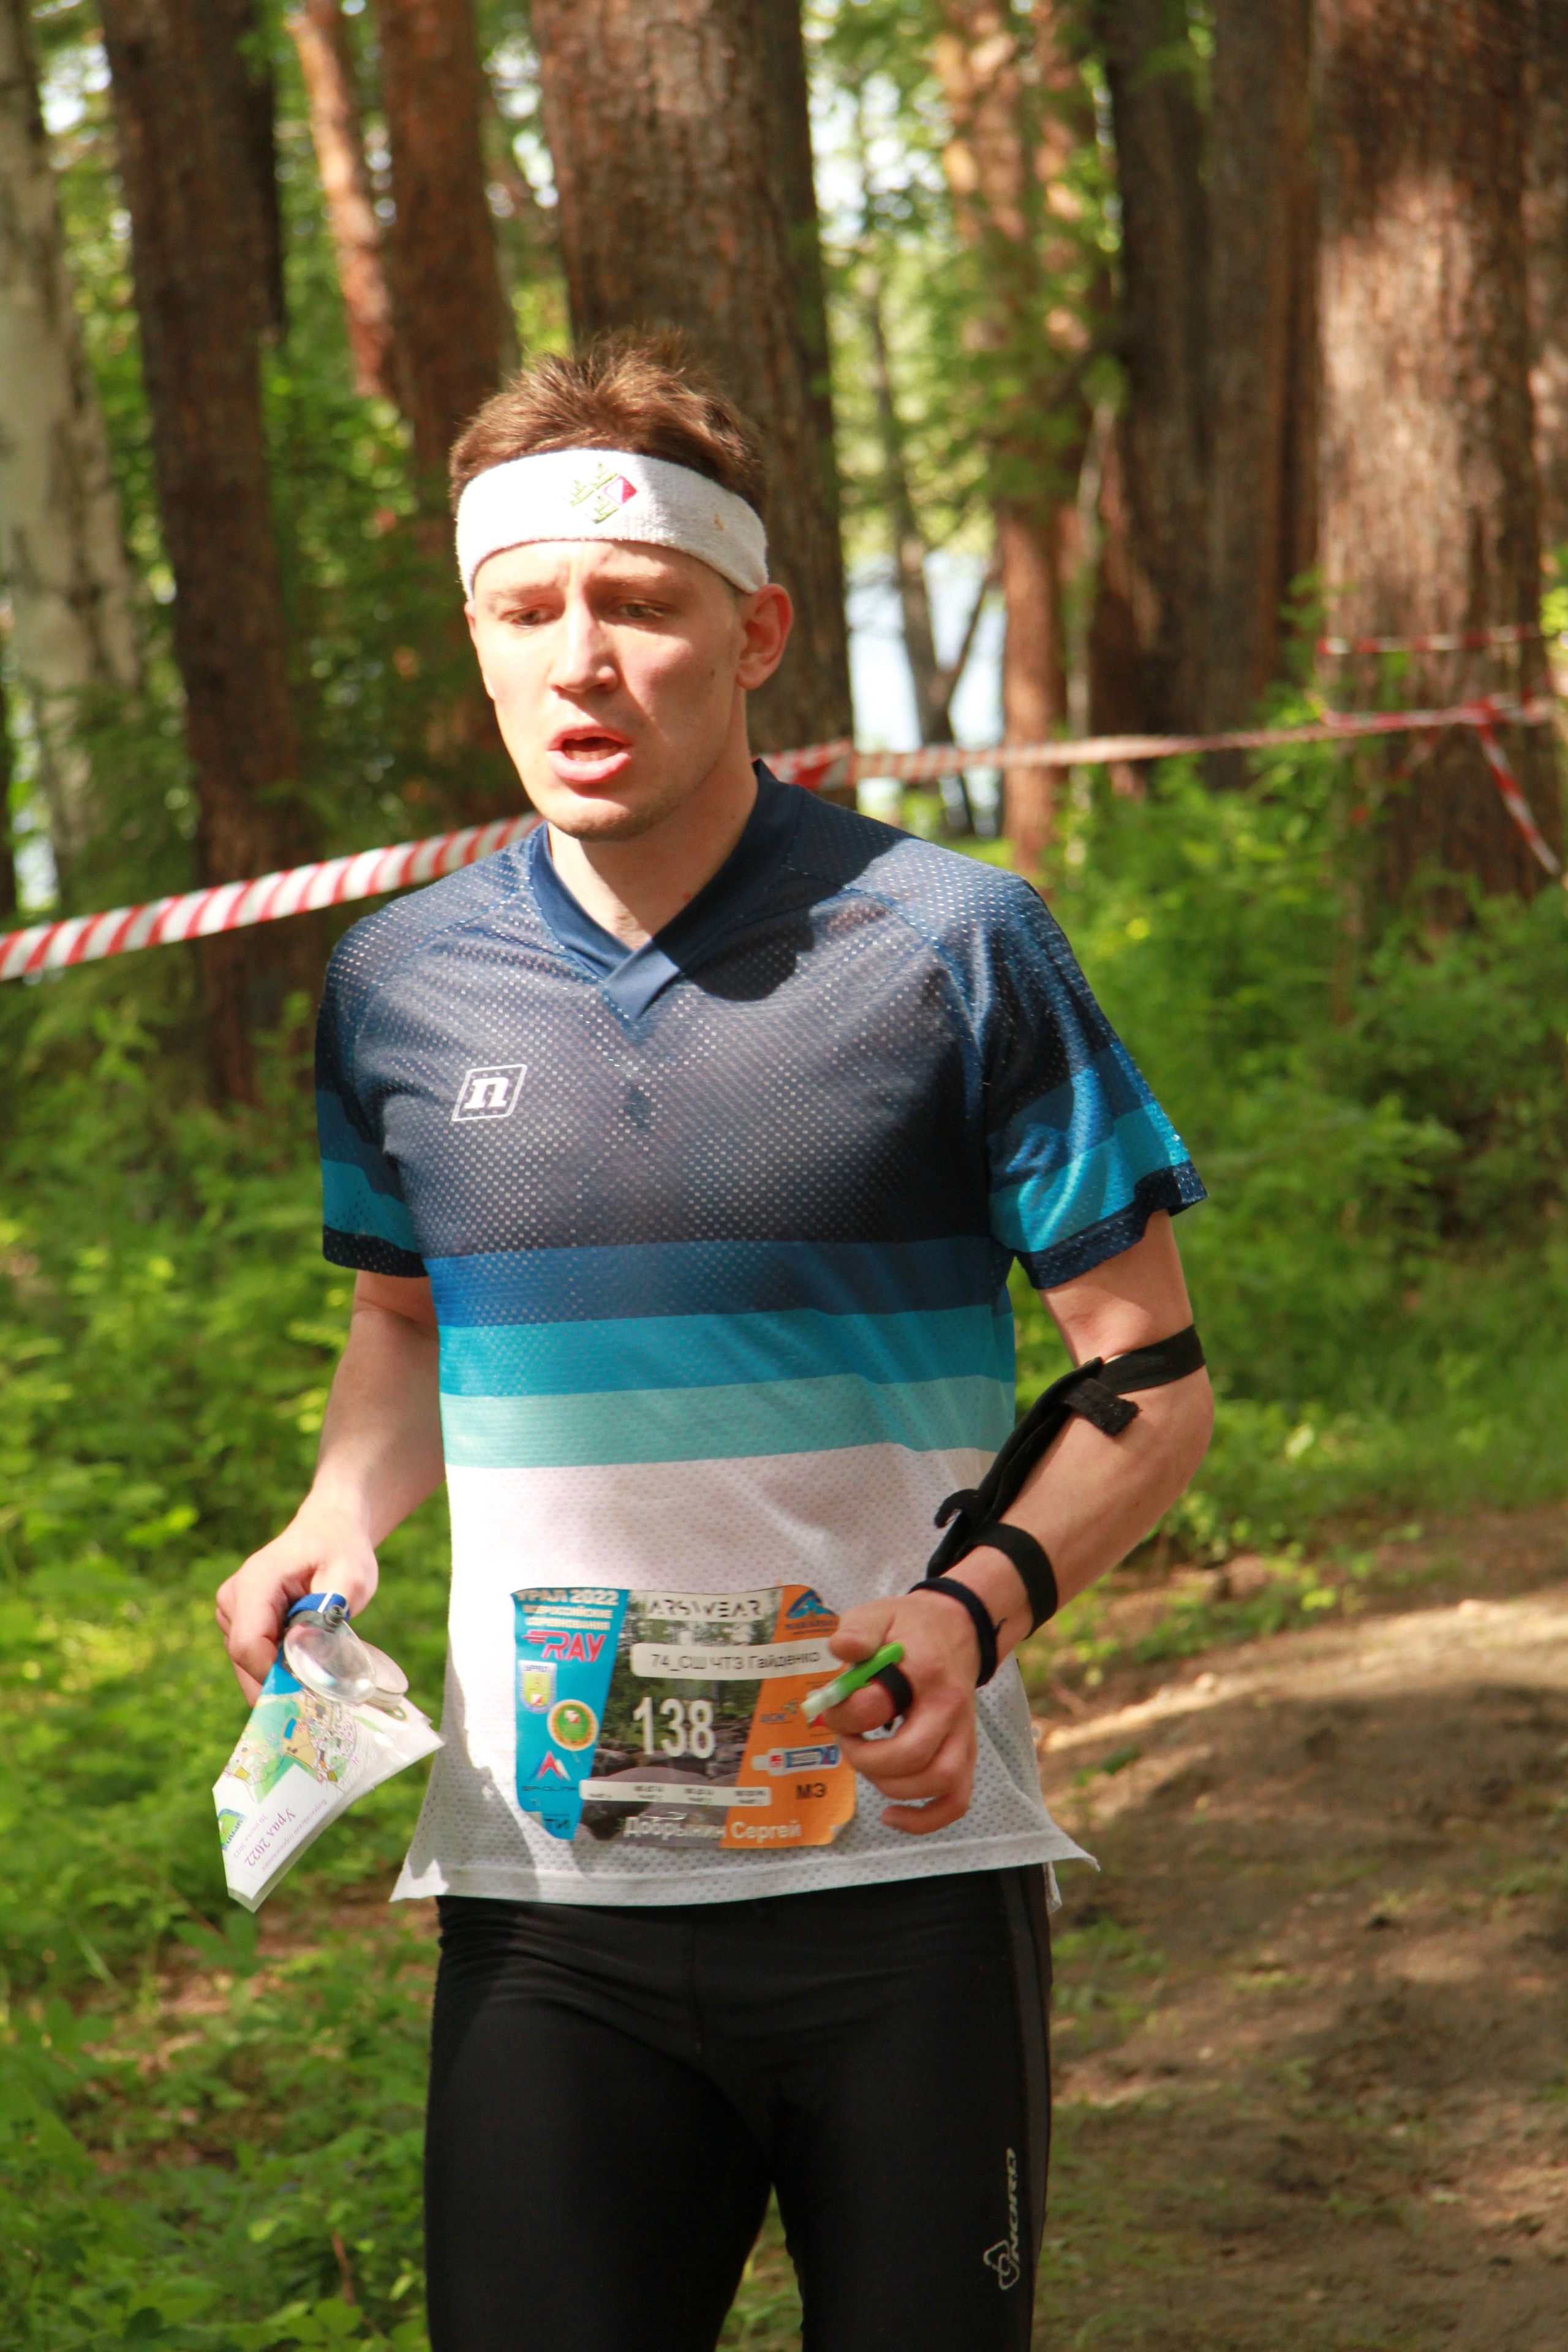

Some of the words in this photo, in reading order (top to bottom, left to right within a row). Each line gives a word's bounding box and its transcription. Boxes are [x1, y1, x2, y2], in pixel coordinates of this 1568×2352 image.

[515, 1588, 568, 1602] УРАЛ
[569, 1589, 619, 1606] 2022
[648, 1598, 763, 1618] ARSWEAR
[521, 1629, 607, 1662] RAY
[709, 1656, 745, 1671] ЧТЗ
[747, 1651, 822, 1670] Гайденко
[632, 1697, 717, 1759] 138
[266, 1807, 296, 1838] Урал
[624, 1815, 726, 1841] Добрынин
[730, 1819, 802, 1844] Сергей
[244, 1838, 271, 1867] 2022
